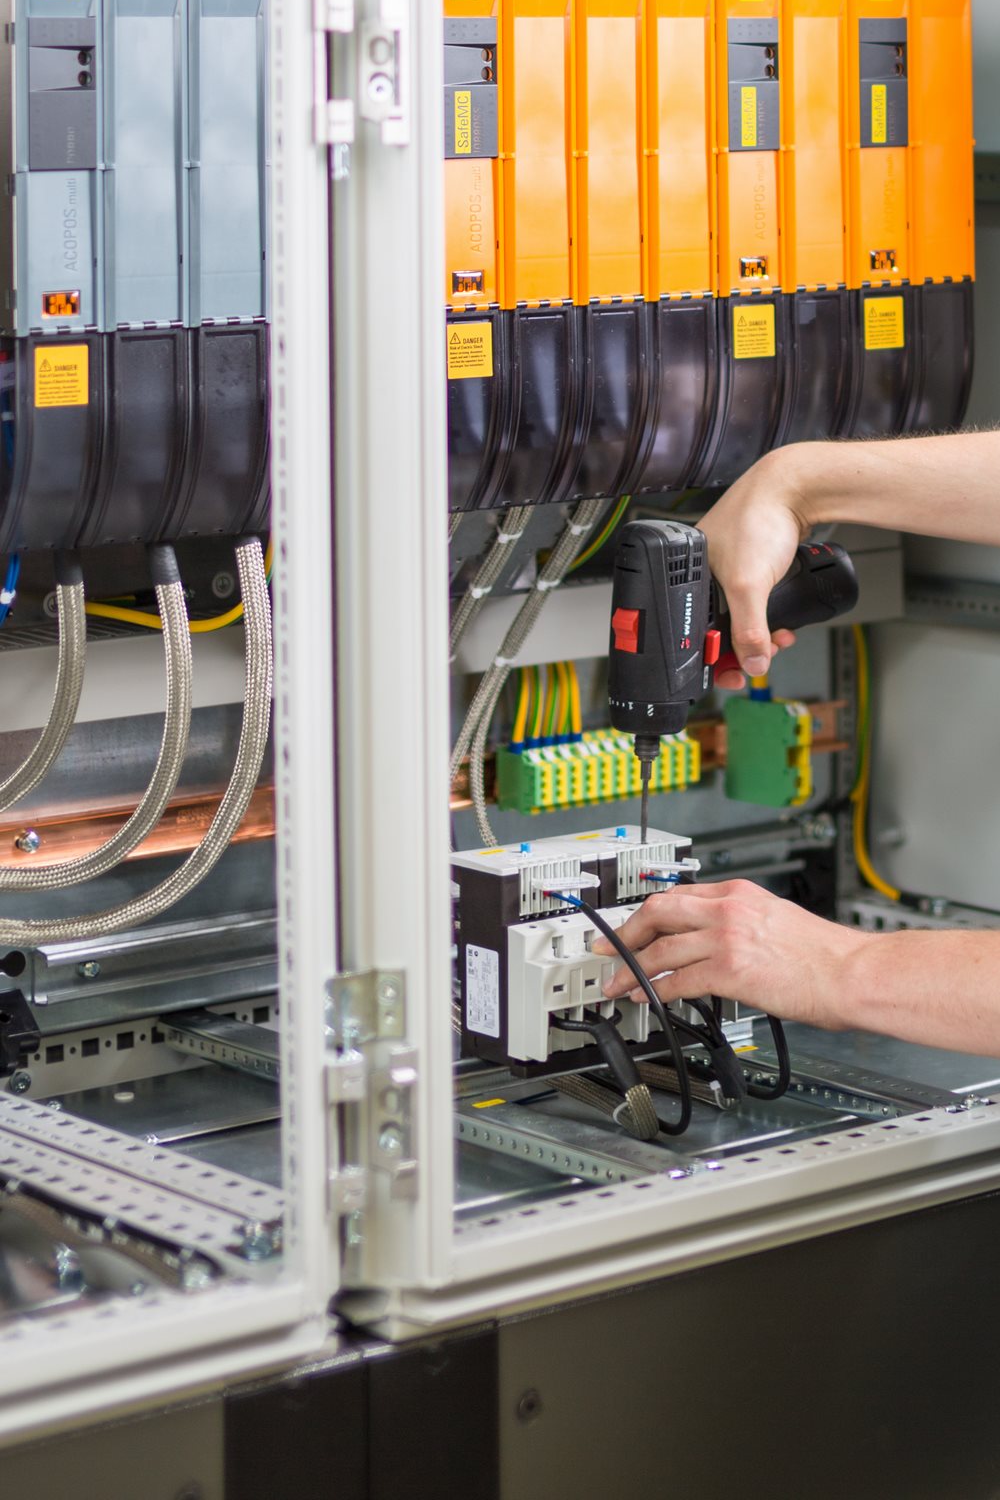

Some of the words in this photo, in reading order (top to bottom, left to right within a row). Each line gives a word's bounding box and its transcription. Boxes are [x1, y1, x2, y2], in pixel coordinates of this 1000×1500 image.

[457, 95, 469, 148] SafeMC
[744, 92, 755, 141] SafeMC
[874, 90, 885, 140] SafeMC
[66, 178, 78, 205] multi
[754, 184, 766, 240] ACOPOS
[63, 208, 78, 272] ACOPOS
[469, 194, 482, 253] ACOPOS
[462, 337, 483, 345] DANGER
